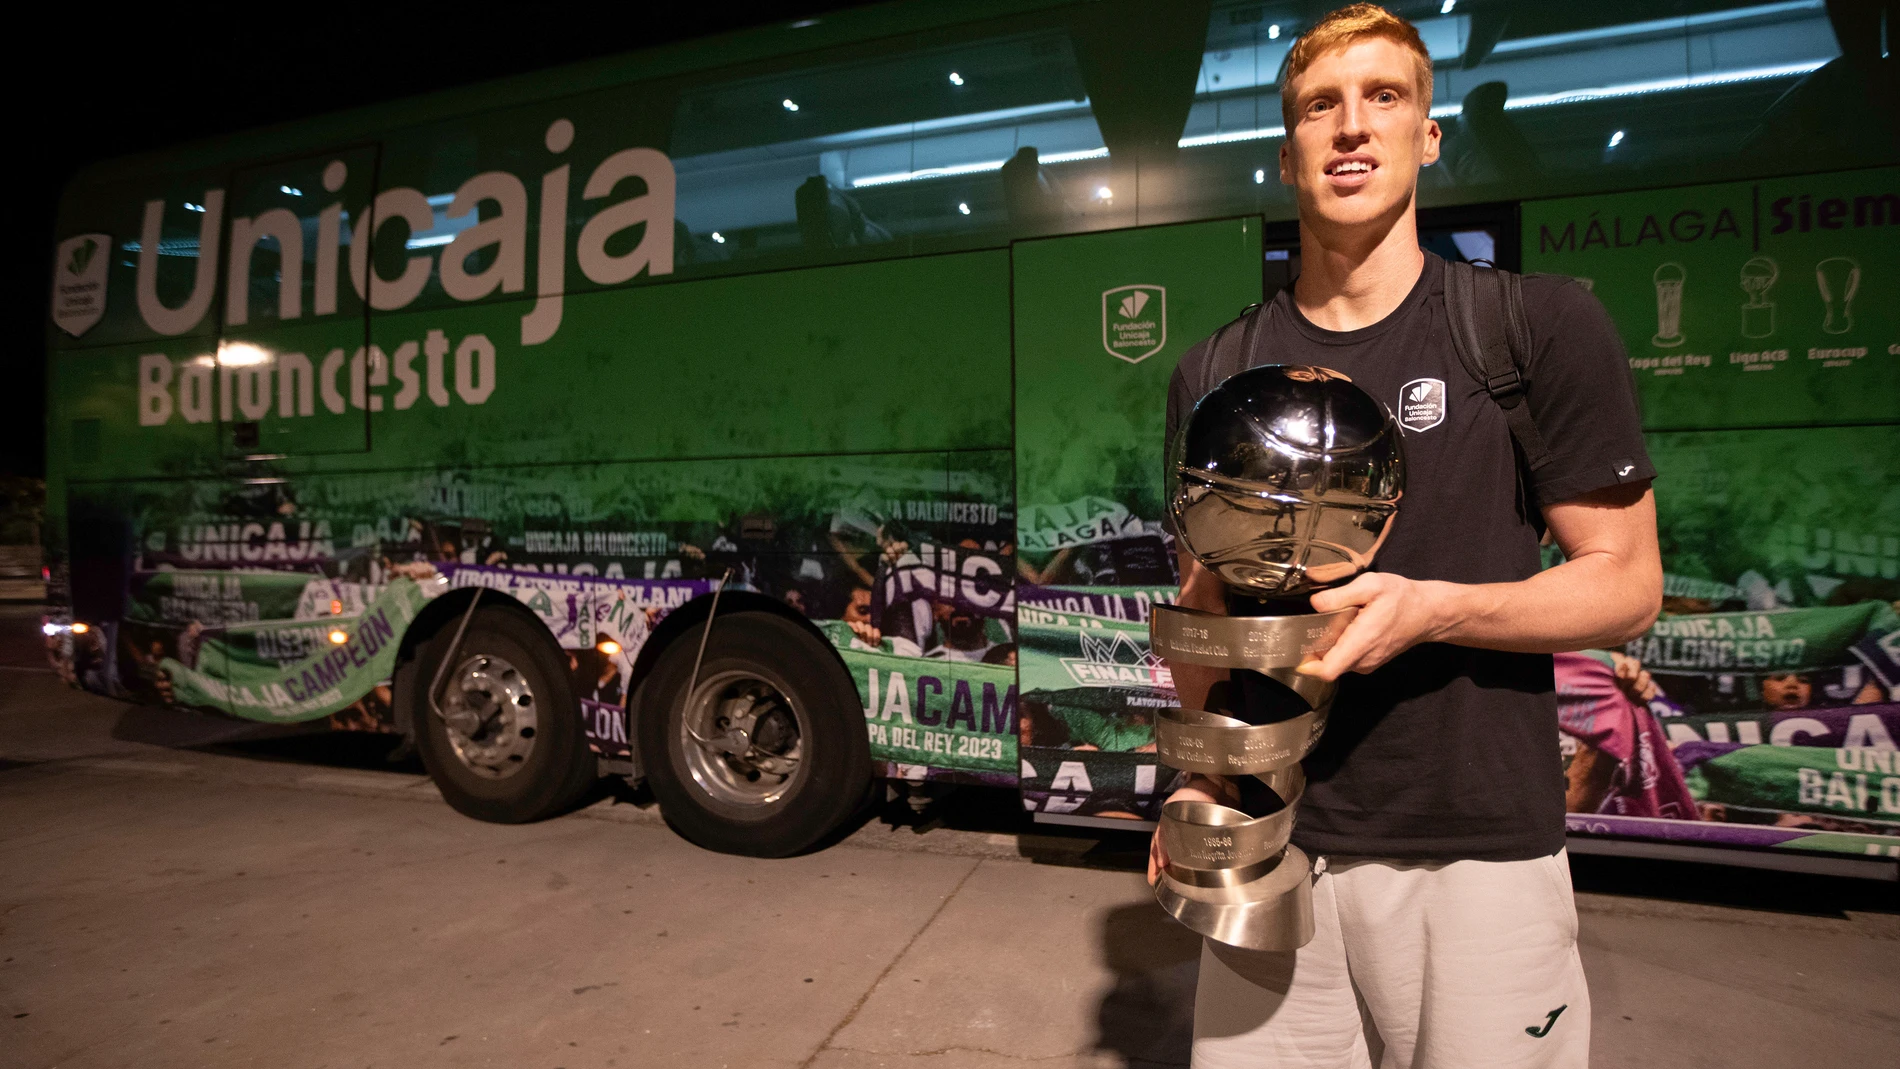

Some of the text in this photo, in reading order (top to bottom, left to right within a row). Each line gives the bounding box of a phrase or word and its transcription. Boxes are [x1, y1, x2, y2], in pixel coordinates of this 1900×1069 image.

[136, 118, 676, 346] Unicaja
[1539, 208, 1742, 253] MÁLAGA
[1112, 321, 1156, 331] Fundación
[1119, 331, 1151, 341] Unicaja
[1112, 339, 1157, 348] Baloncesto
[138, 329, 497, 427] Baloncesto
[1404, 403, 1437, 411] Fundación
[1408, 409, 1433, 418] Unicaja
[906, 500, 998, 526] BALONCESTO
[177, 520, 336, 561] UNICAJA
[525, 531, 581, 553] UNICAJA
[1071, 663, 1152, 684] FINAL
[891, 726, 920, 751] DEL
[923, 730, 955, 755] REY
[957, 735, 1003, 760] 2023
